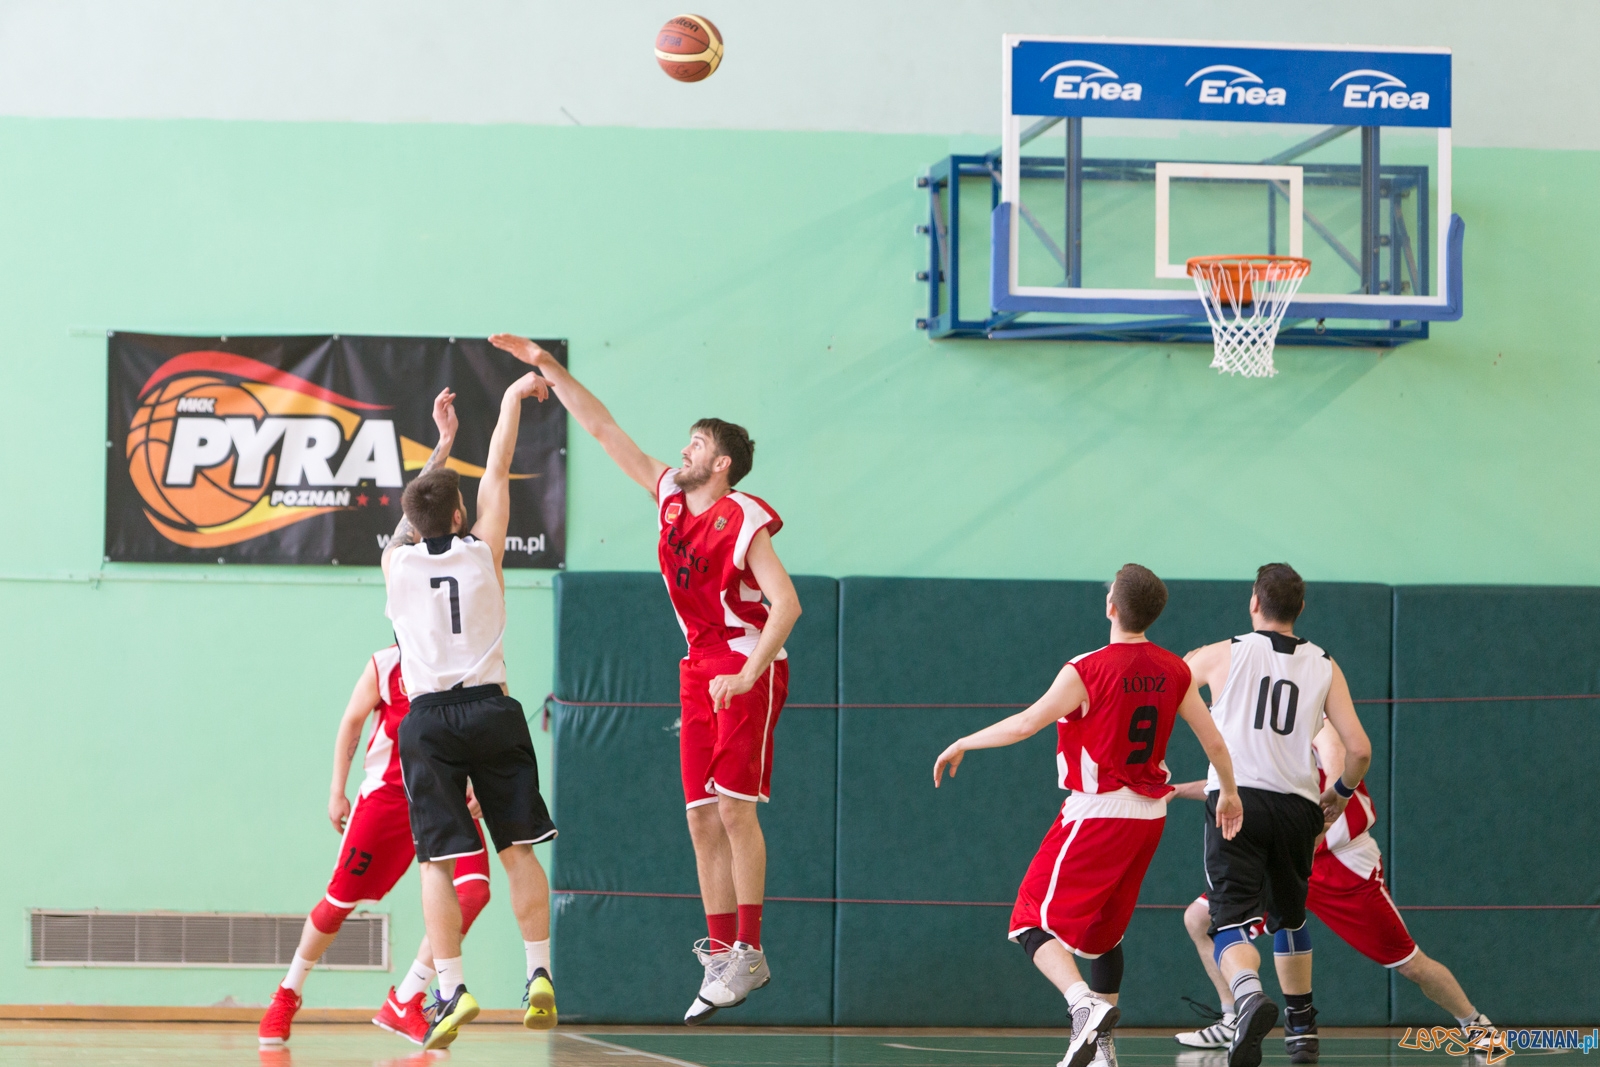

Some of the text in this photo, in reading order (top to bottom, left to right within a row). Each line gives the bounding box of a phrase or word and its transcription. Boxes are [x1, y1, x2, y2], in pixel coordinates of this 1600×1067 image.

[1053, 75, 1142, 101] Enea
[1199, 80, 1287, 106] Enea
[1343, 84, 1430, 110] Enea
[177, 397, 214, 413] MKK
[165, 417, 403, 487] PYRA
[270, 487, 349, 507] POZNAŃ
[430, 576, 461, 634] 7
[1122, 671, 1166, 693] ŁÓDŹ
[1254, 676, 1299, 736] 10
[1126, 705, 1158, 765] 9
[343, 847, 373, 876] 13
